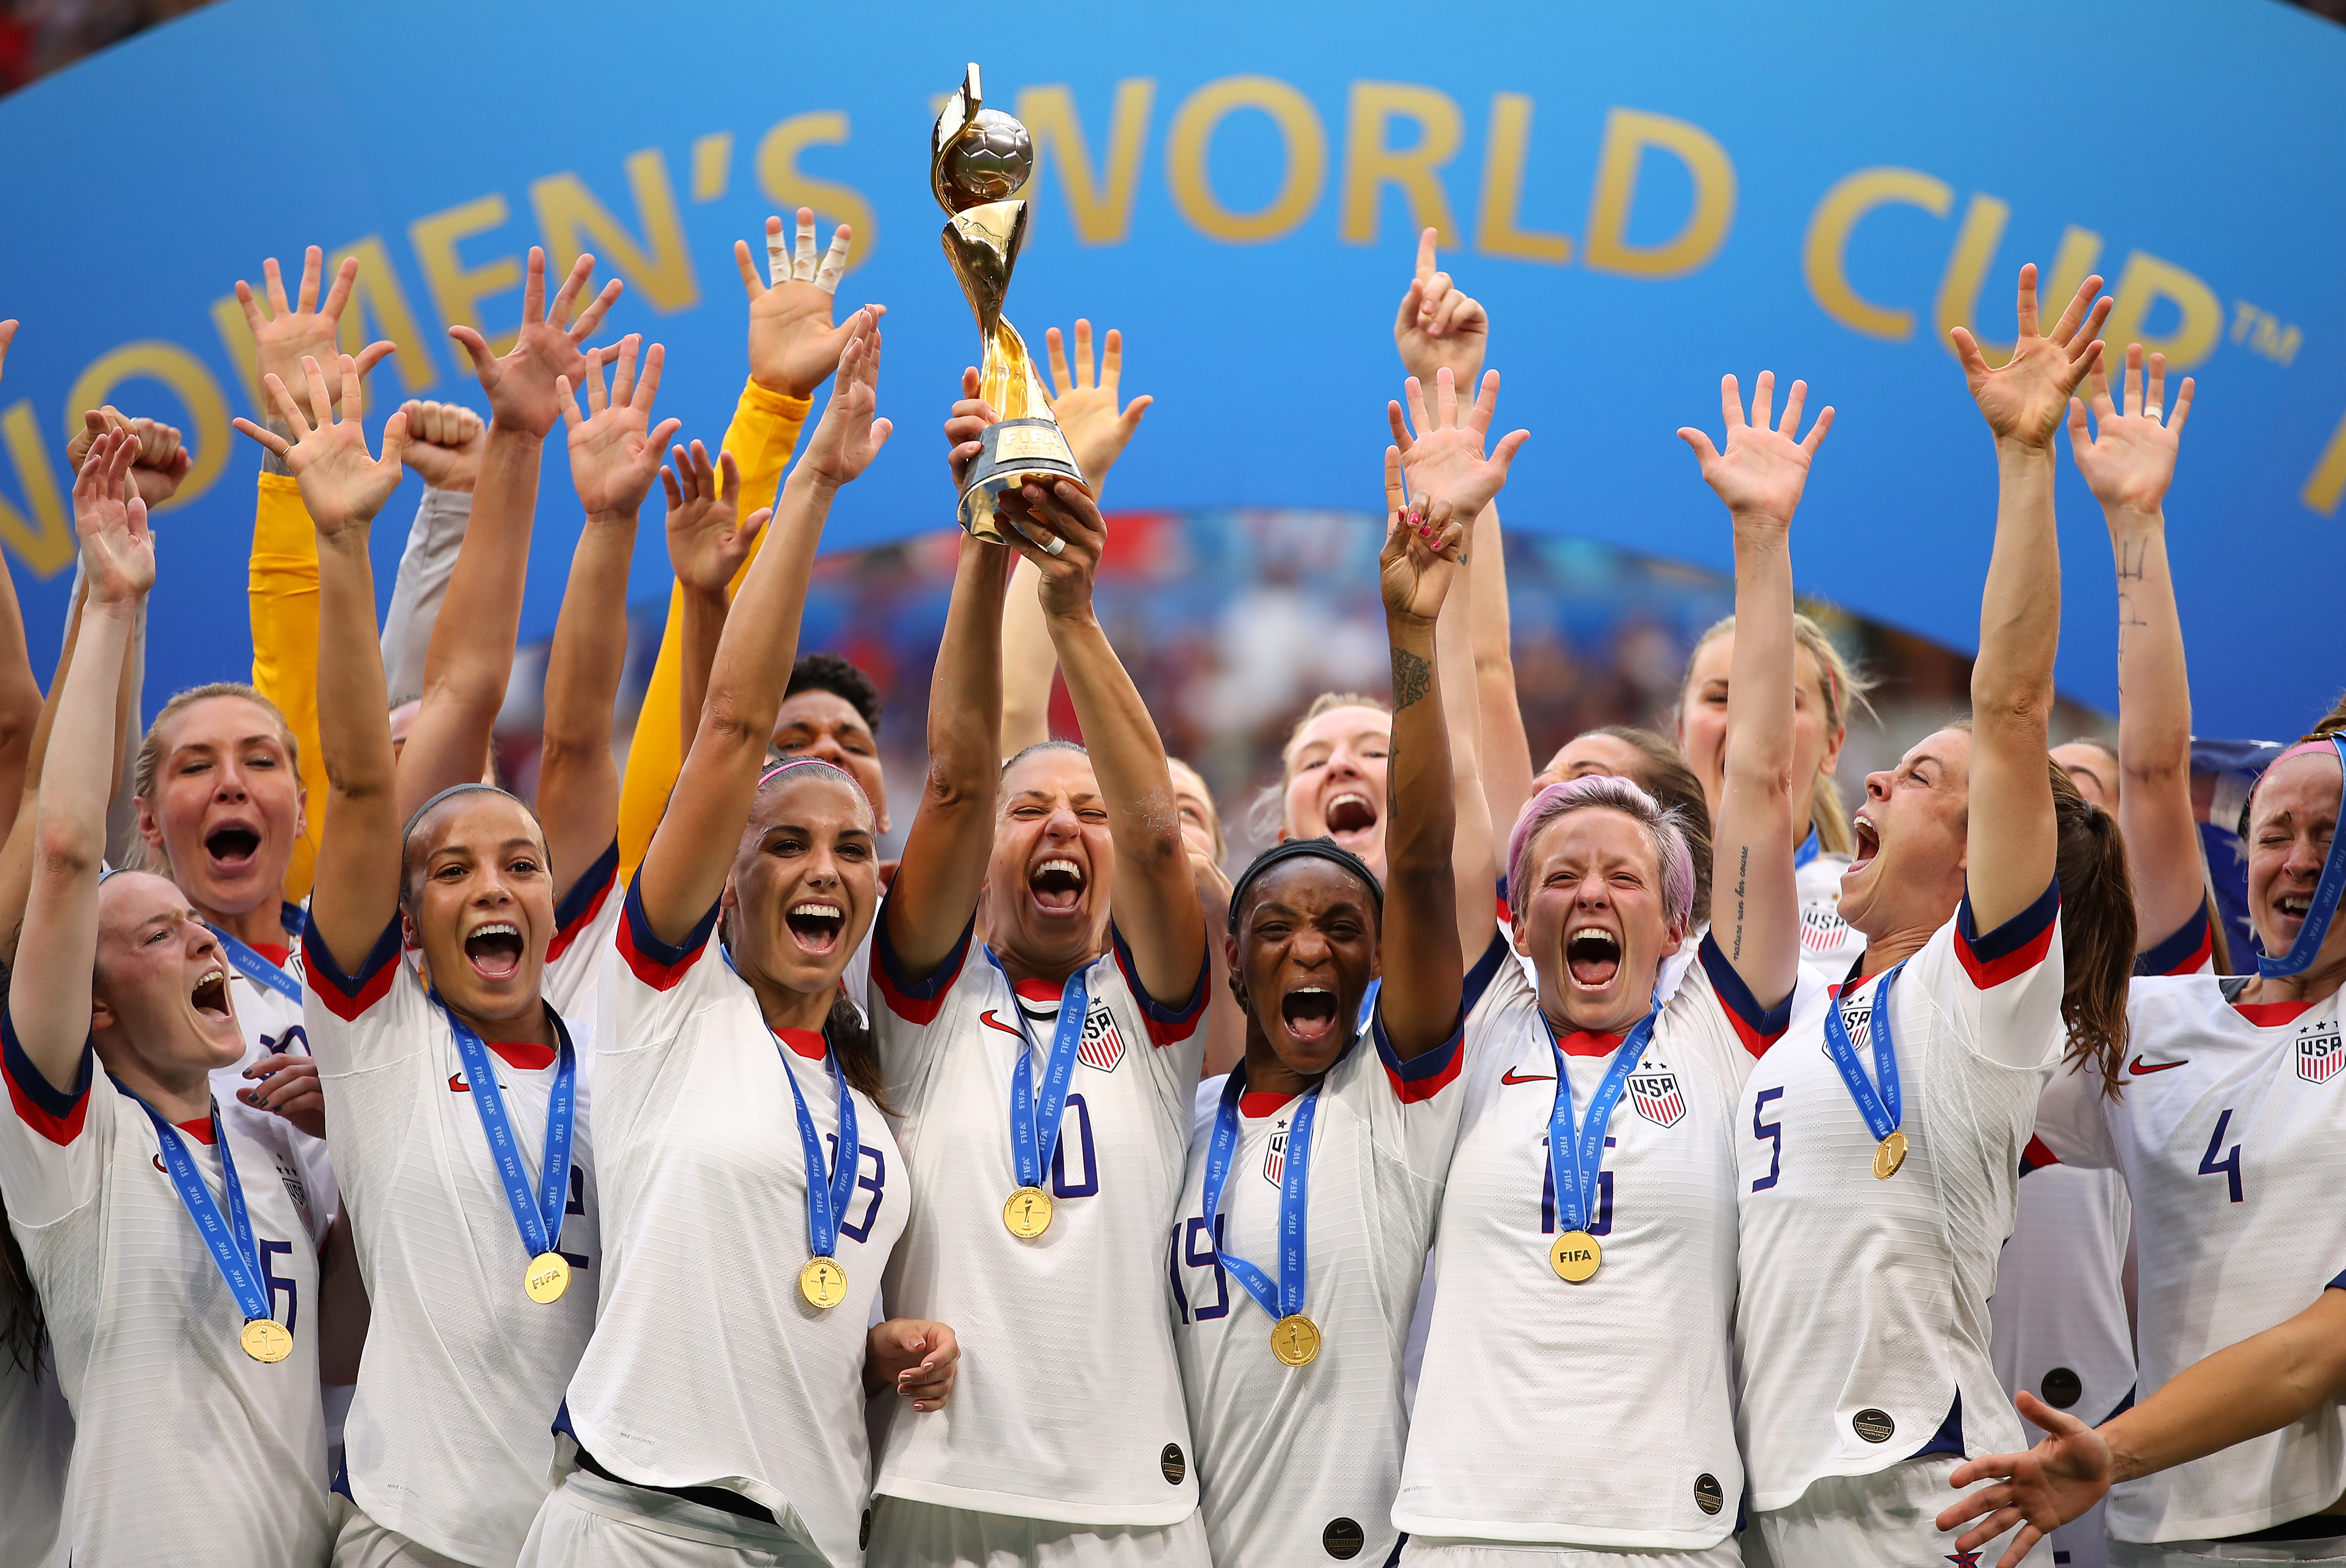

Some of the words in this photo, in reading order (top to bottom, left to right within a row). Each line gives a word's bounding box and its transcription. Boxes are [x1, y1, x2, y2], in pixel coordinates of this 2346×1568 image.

[929, 74, 1737, 278] WORLD
[1004, 429, 1061, 448] FIFA
[1740, 846, 1749, 877] course
[1734, 879, 1745, 898] her
[1734, 924, 1743, 962] nature
[1081, 1012, 1111, 1039] SA
[2301, 1036, 2342, 1057] USA
[1632, 1078, 1674, 1098] USA
[1752, 1086, 1785, 1193] 5
[2198, 1108, 2244, 1203] 4
[1032, 1189, 1045, 1198] WORLD
[1170, 1213, 1229, 1325] 19
[1560, 1249, 1592, 1264] FIFA
[532, 1267, 560, 1290] FIFA
